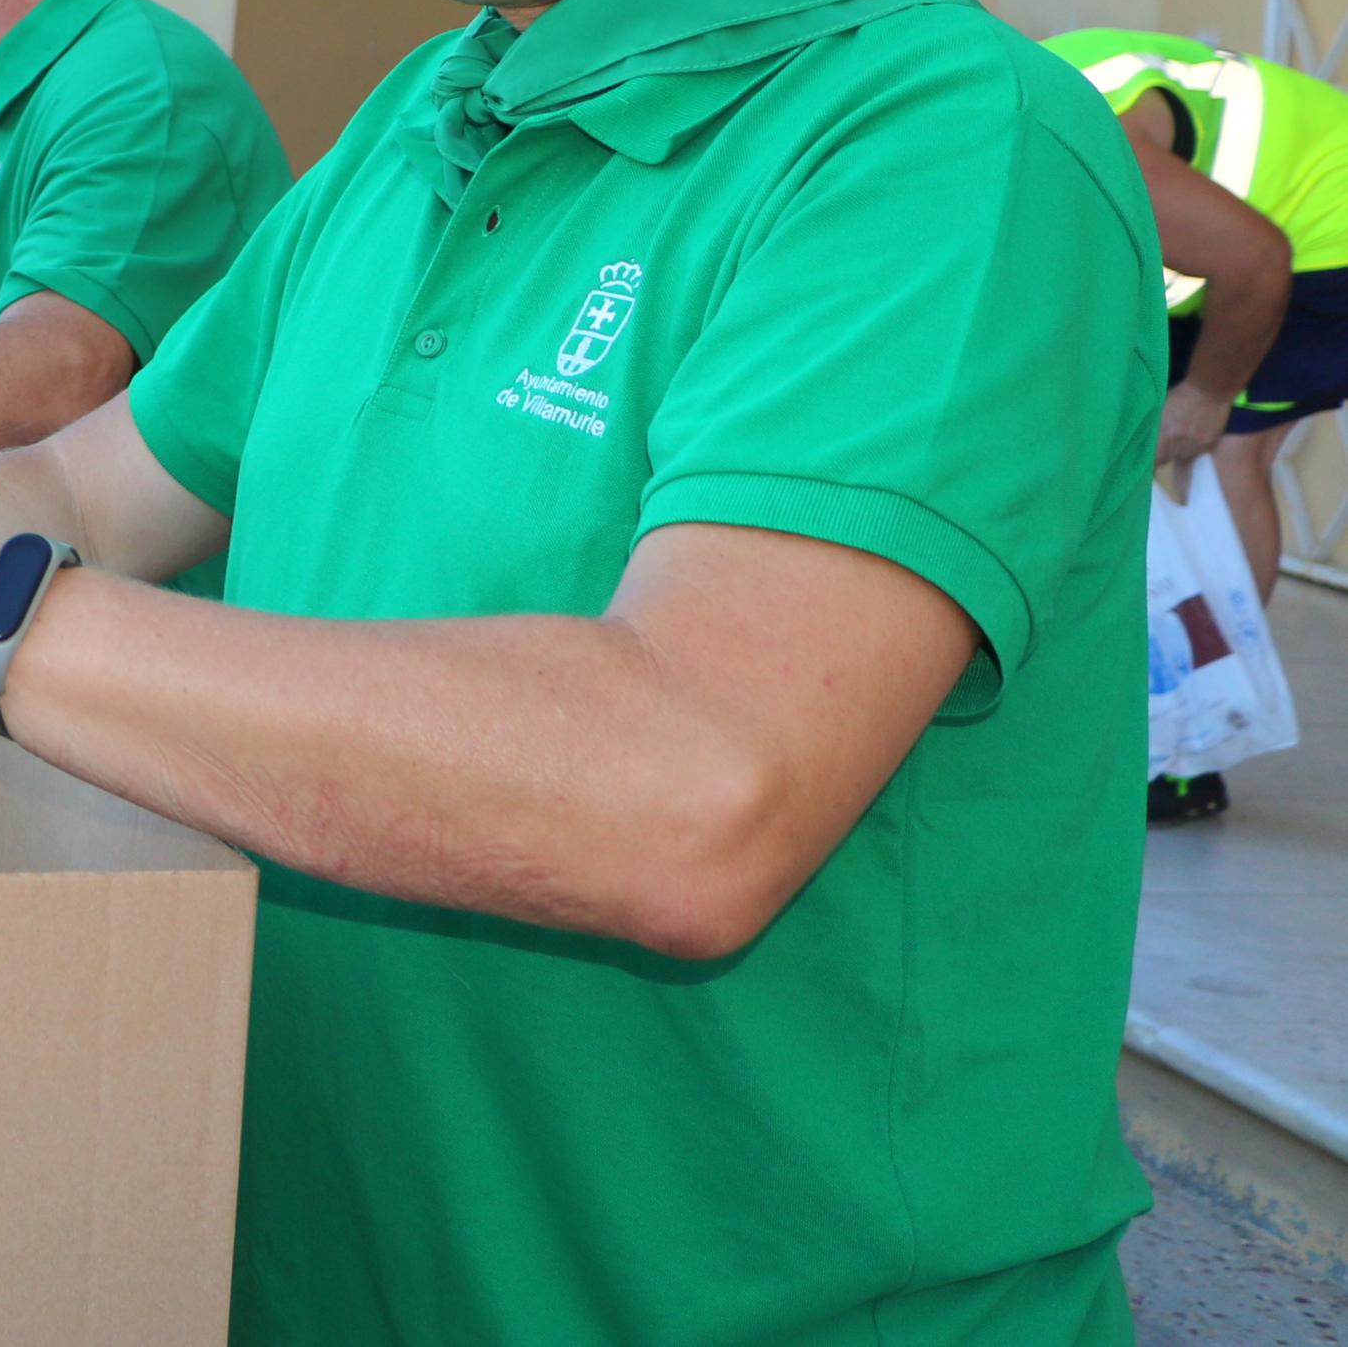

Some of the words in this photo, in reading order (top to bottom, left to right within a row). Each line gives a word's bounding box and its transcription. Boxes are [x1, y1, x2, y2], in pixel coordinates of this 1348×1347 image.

[515, 368, 609, 409] Ayuntamiento
[496, 387, 520, 408] de
[522, 390, 606, 437] Villamurie
